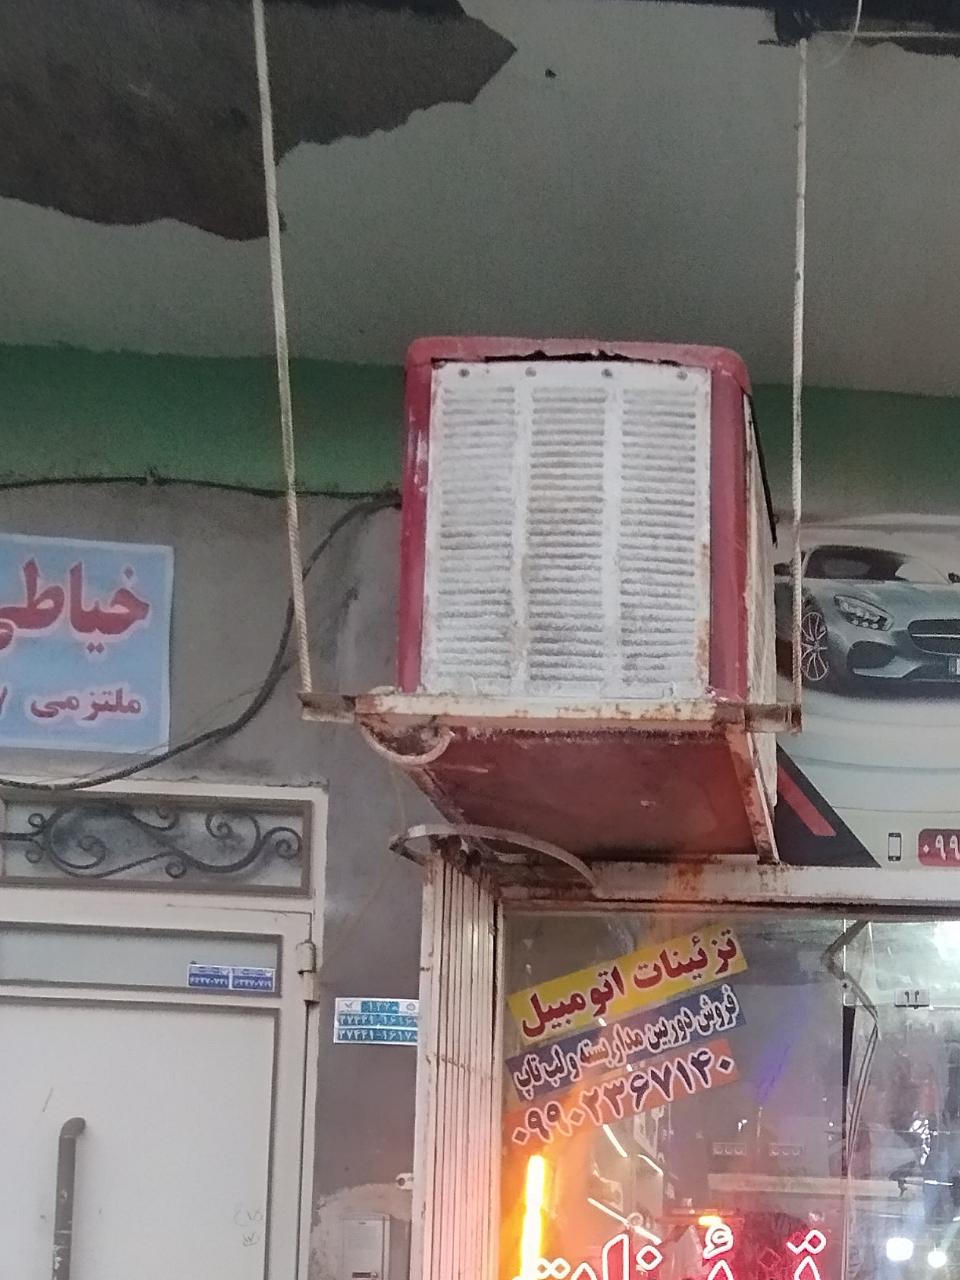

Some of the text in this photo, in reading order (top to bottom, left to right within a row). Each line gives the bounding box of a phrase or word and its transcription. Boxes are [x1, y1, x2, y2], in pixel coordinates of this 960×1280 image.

[522, 928, 738, 1038] تزئینات اتومبیل
[695, 983, 739, 1036] فروش
[511, 1047, 735, 1145] ۰۹۹۰۲۳۶۷۱۴۰
